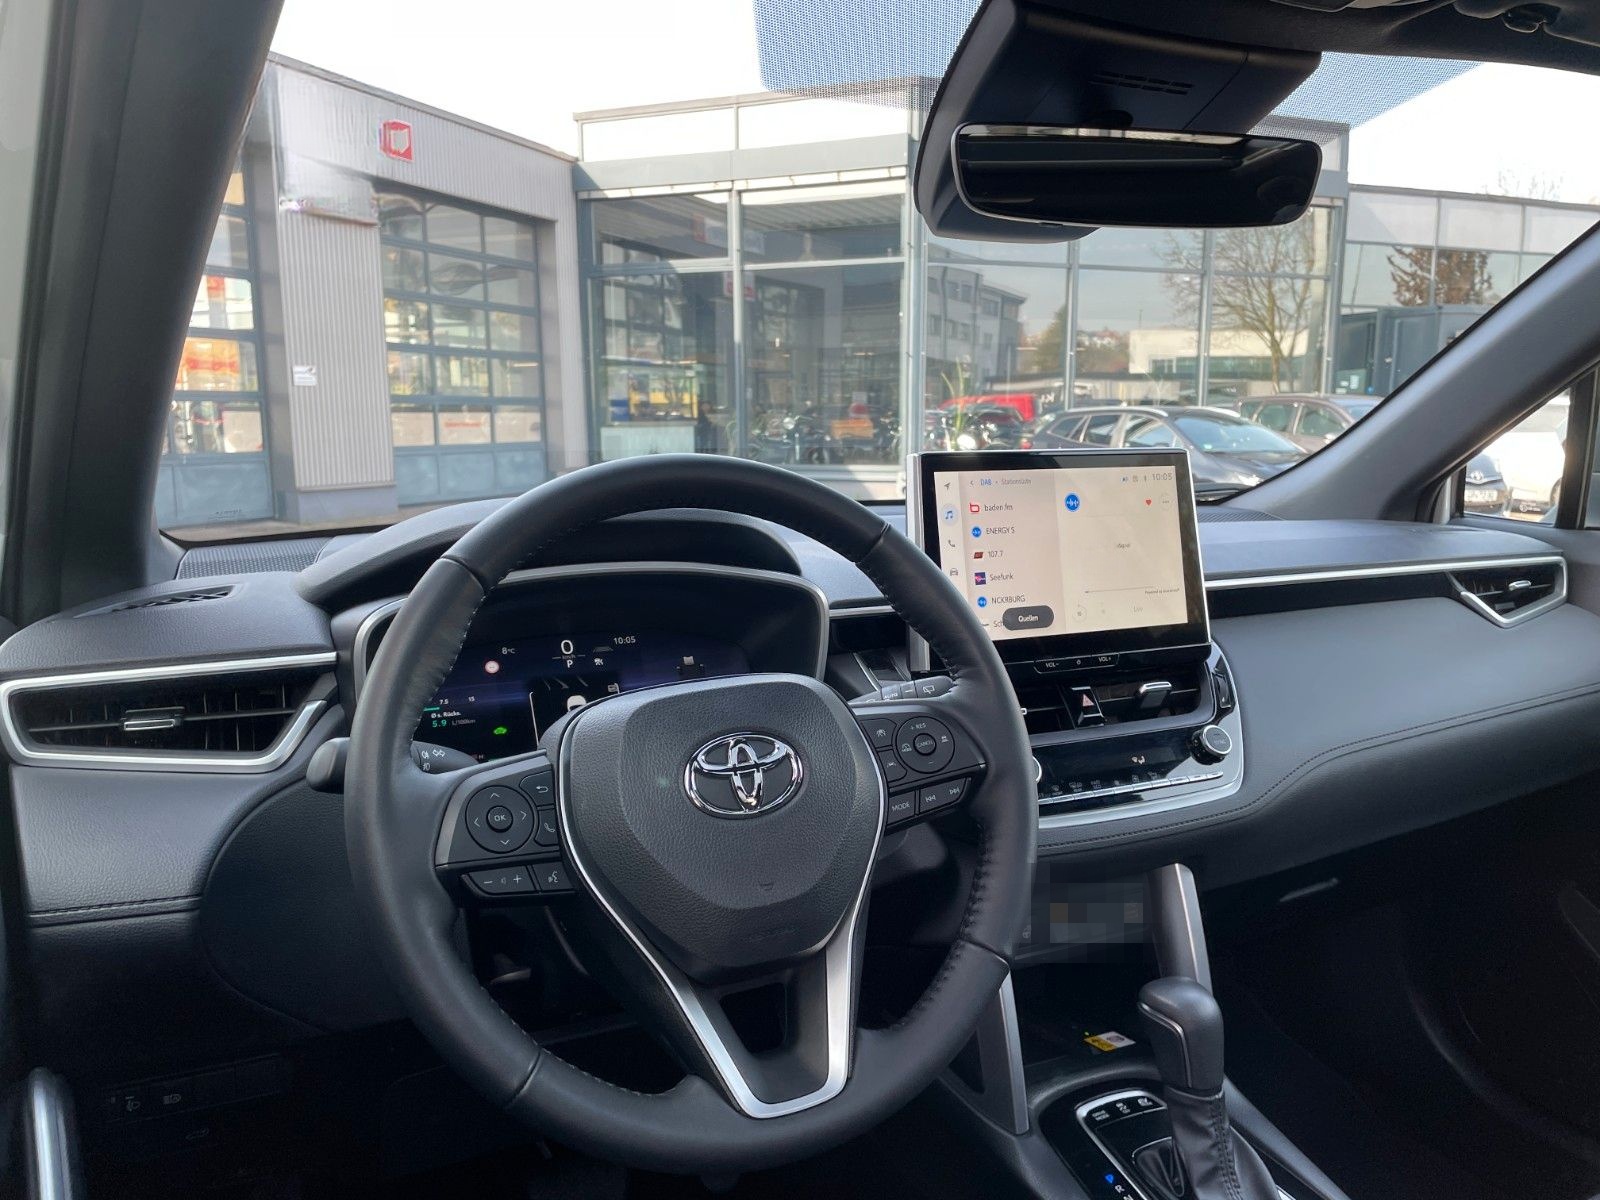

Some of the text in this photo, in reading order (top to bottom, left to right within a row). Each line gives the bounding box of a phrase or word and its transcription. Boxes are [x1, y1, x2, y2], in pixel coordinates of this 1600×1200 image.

[1151, 473, 1173, 481] 10:05
[980, 478, 992, 486] DAB
[986, 526, 1010, 535] ENERGY
[988, 550, 1003, 558] 107.7
[1017, 615, 1039, 623] Quellen
[613, 635, 637, 645] 10:05
[560, 639, 574, 655] 0
[566, 659, 573, 668] P
[432, 719, 447, 728] 5.9
[891, 802, 910, 812] MODE
[494, 814, 507, 822] OK
[1114, 1184, 1125, 1194] R
